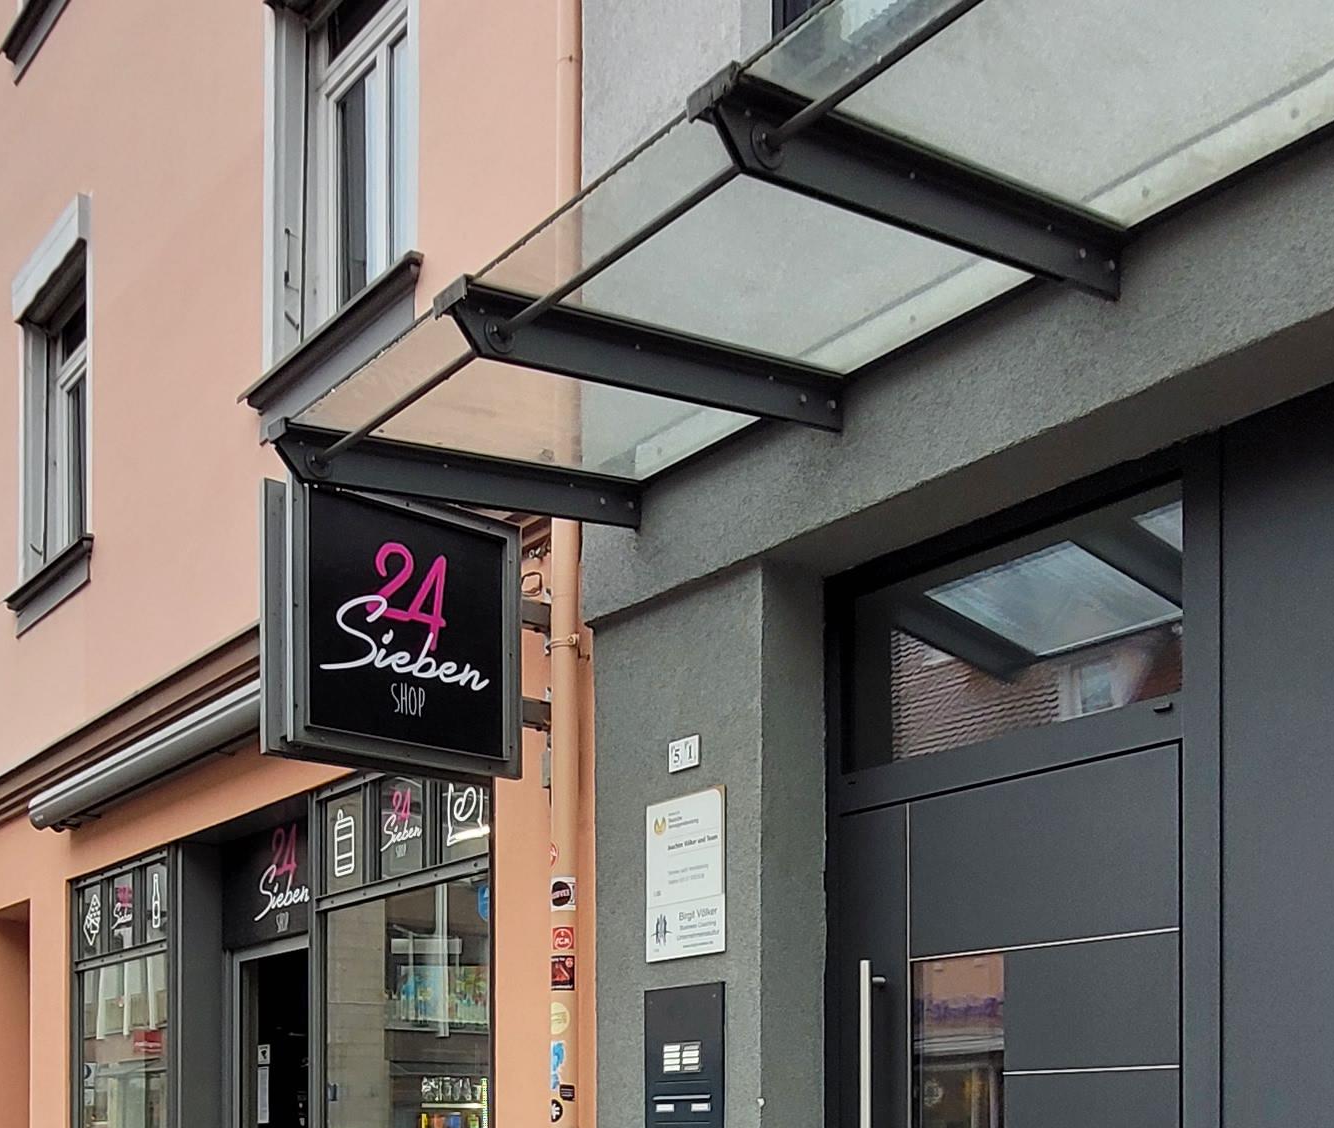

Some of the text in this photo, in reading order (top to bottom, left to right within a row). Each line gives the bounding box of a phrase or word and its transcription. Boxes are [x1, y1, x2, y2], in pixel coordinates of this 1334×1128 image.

[365, 541, 447, 652] 24
[319, 594, 490, 692] Sieben
[390, 682, 426, 718] SHOP
[268, 823, 298, 883] 24
[380, 813, 423, 852] Sieben
[253, 863, 310, 922] Sieben
